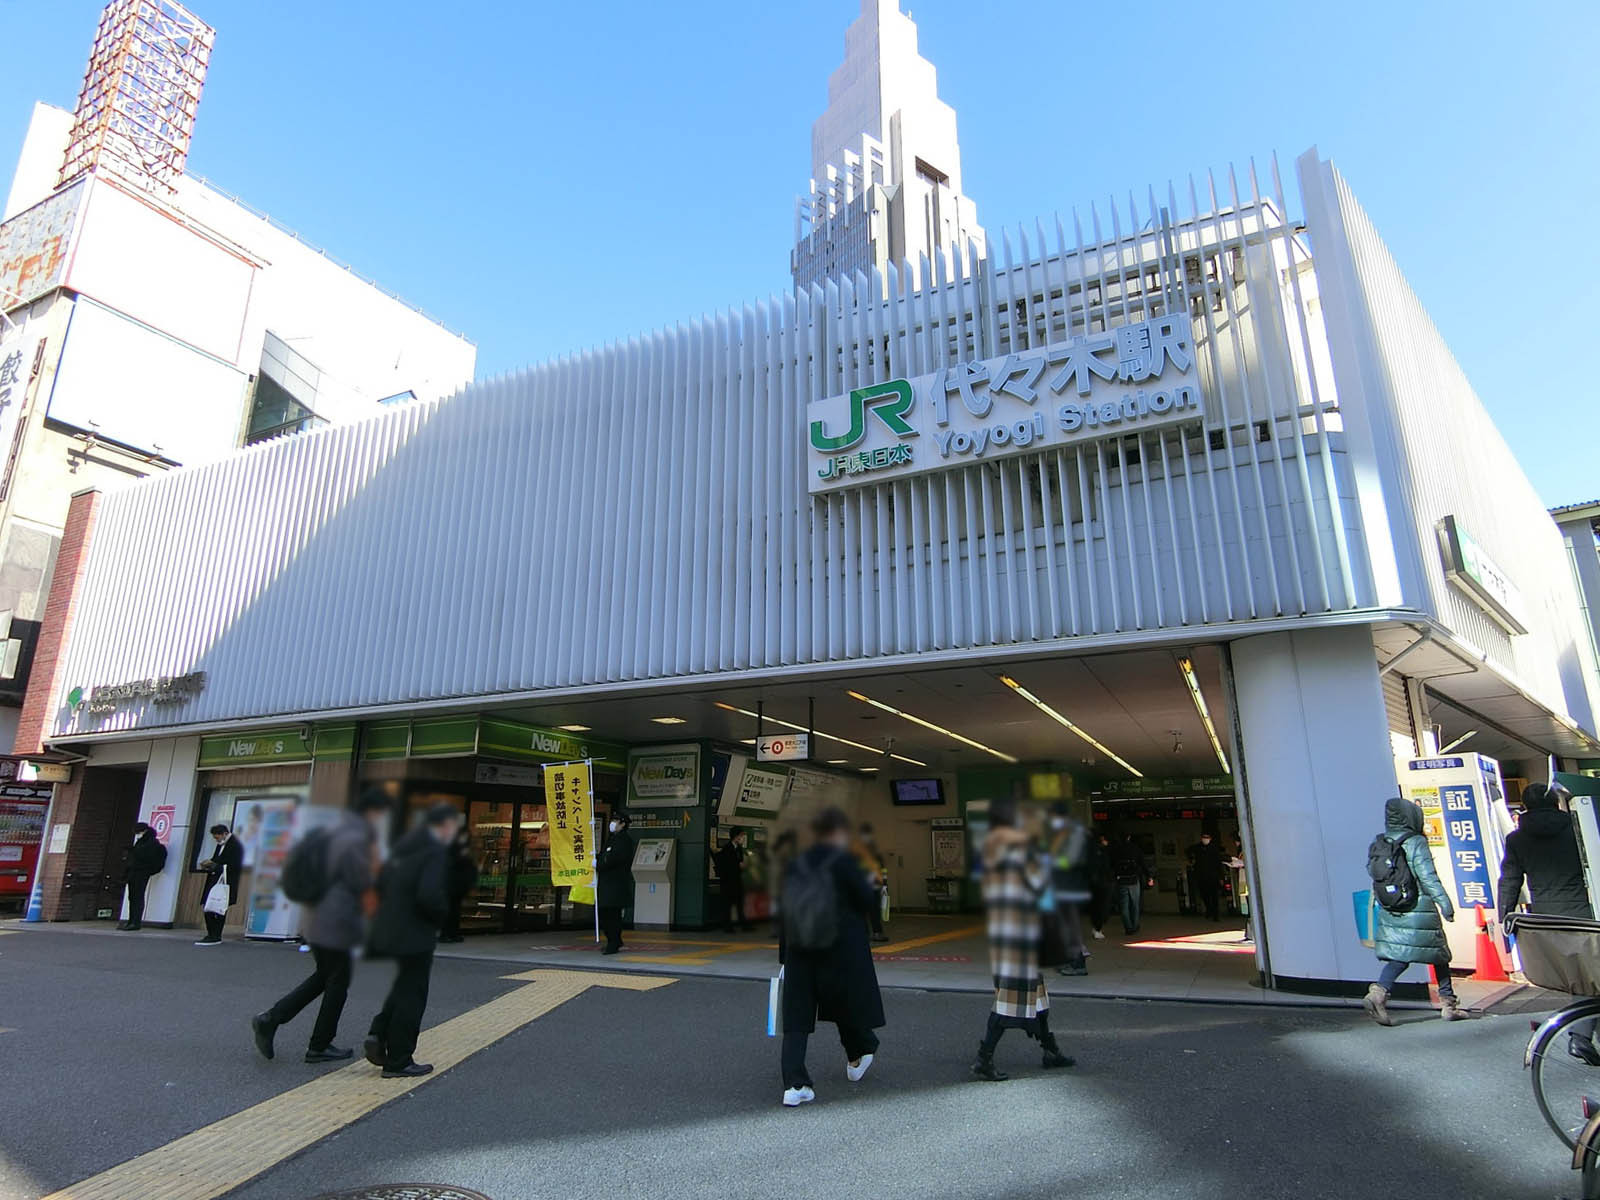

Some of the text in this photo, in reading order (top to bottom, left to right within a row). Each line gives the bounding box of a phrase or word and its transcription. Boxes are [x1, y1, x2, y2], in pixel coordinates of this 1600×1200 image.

[929, 312, 1191, 426] 代々木駅
[810, 378, 919, 452] JR
[933, 384, 1198, 457] Yoyogi Station
[817, 443, 912, 479] JR東日本
[228, 740, 284, 757] NewDays
[531, 733, 588, 758] NewDays
[638, 766, 693, 780] NewDays
[1445, 790, 1487, 903] 証明写真
